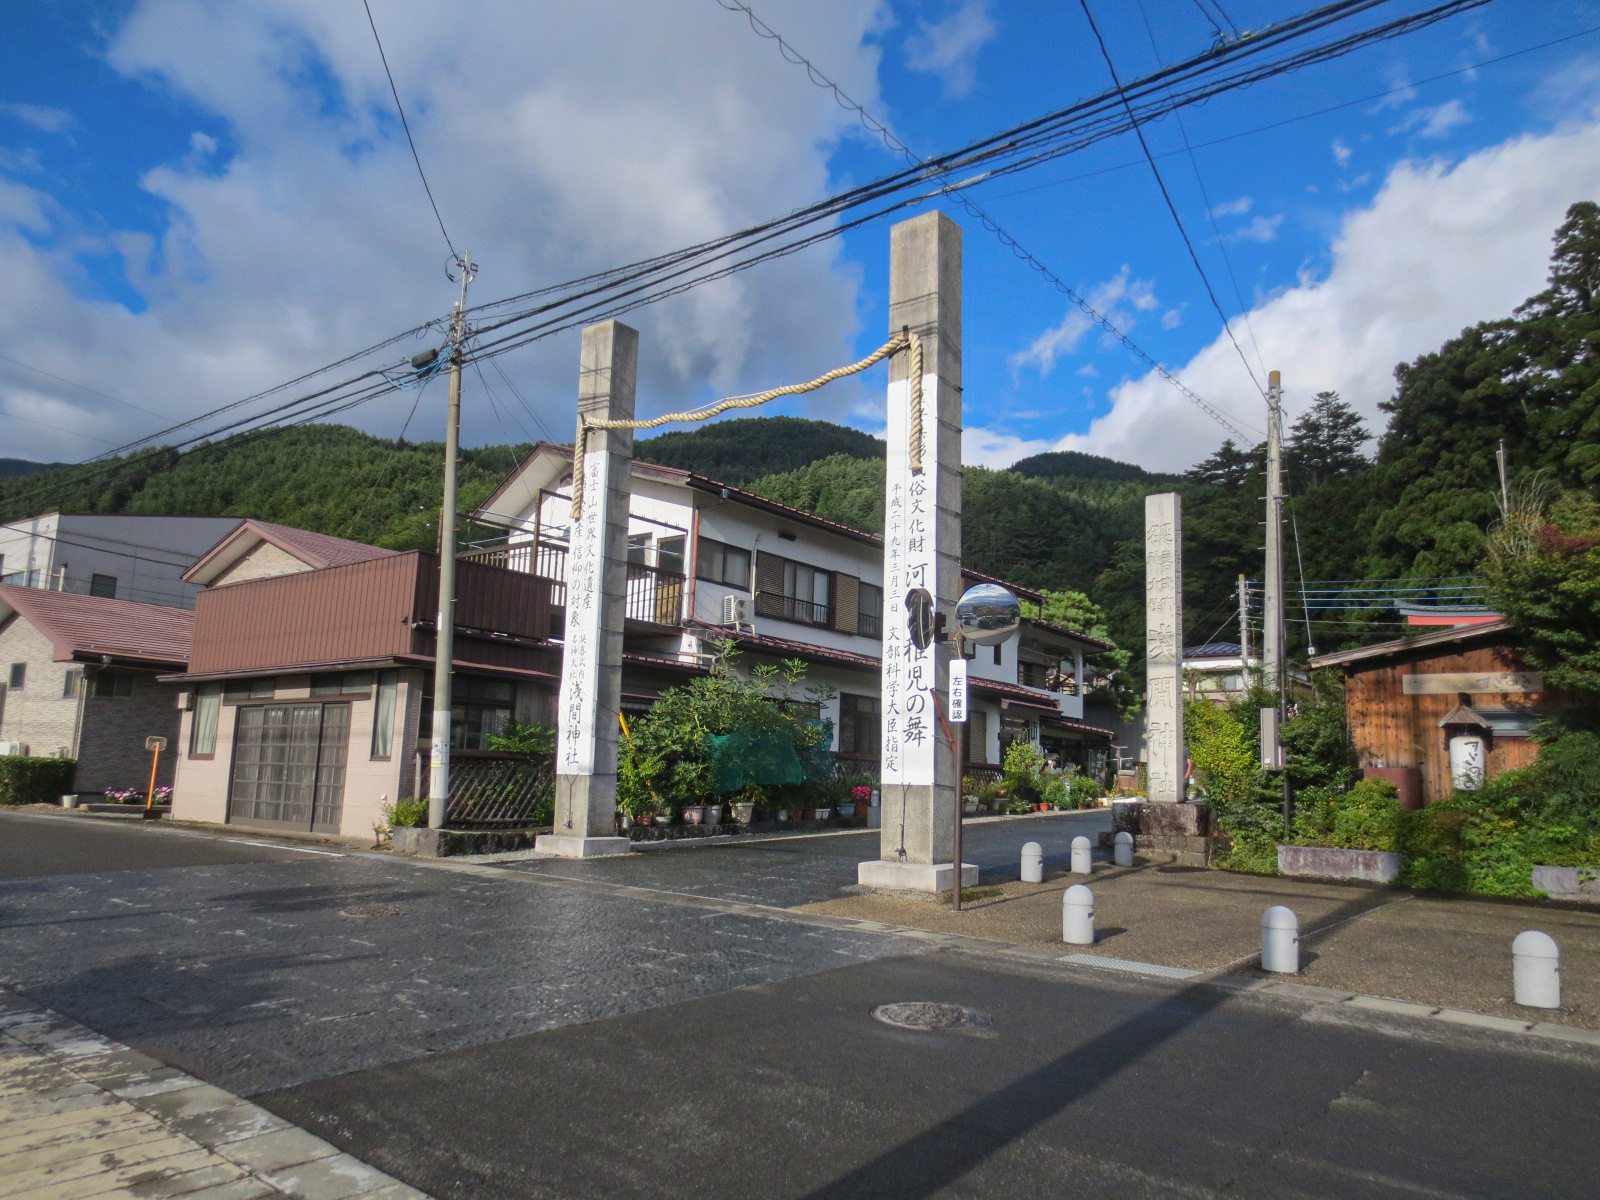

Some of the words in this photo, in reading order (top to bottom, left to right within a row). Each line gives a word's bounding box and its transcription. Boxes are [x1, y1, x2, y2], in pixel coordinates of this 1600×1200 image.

[582, 462, 600, 610] 富士山世界文化遺産
[889, 482, 902, 612] 平成二十九年三月三日
[885, 625, 901, 772] 文部科学大臣指定
[902, 562, 929, 748] 河稚児の舞
[952, 676, 963, 720] 左右確認
